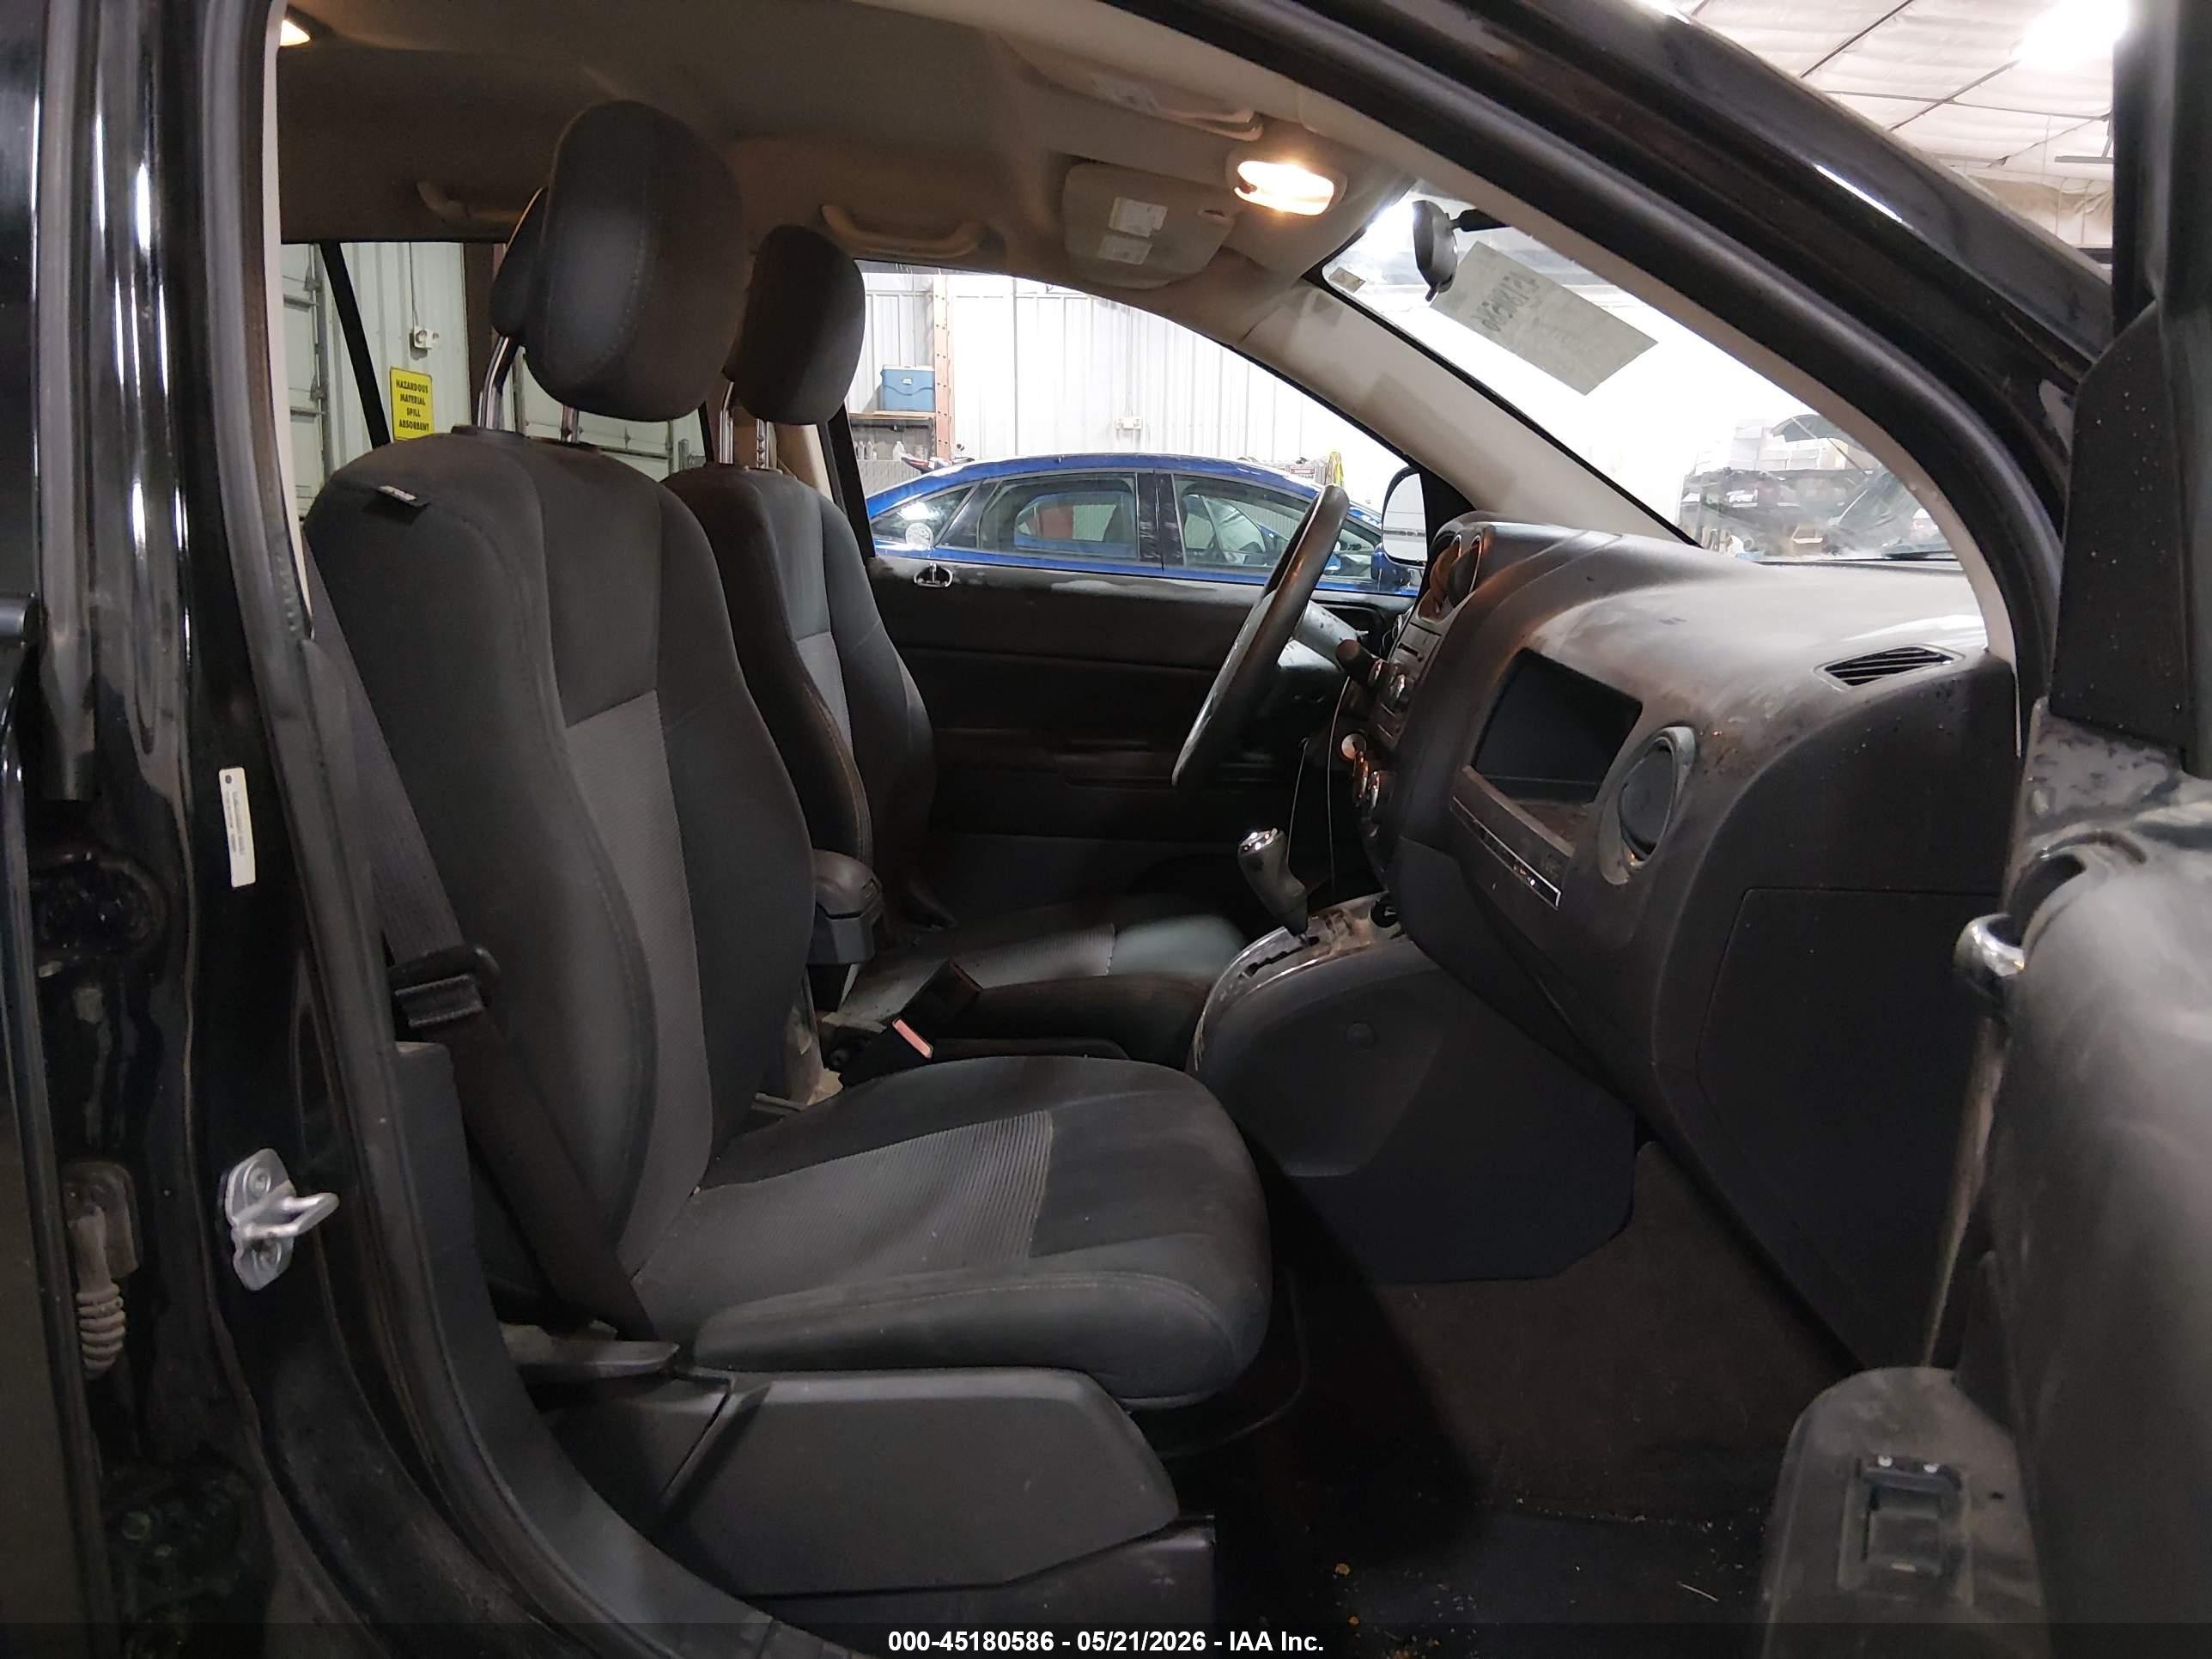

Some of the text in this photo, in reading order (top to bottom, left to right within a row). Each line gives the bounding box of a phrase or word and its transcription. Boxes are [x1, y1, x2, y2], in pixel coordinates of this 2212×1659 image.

[396, 379, 428, 393] HAZARDOUS
[399, 392, 426, 405] MATERIAL
[406, 407, 421, 417] SPILL
[398, 418, 429, 432] ABSORBENT
